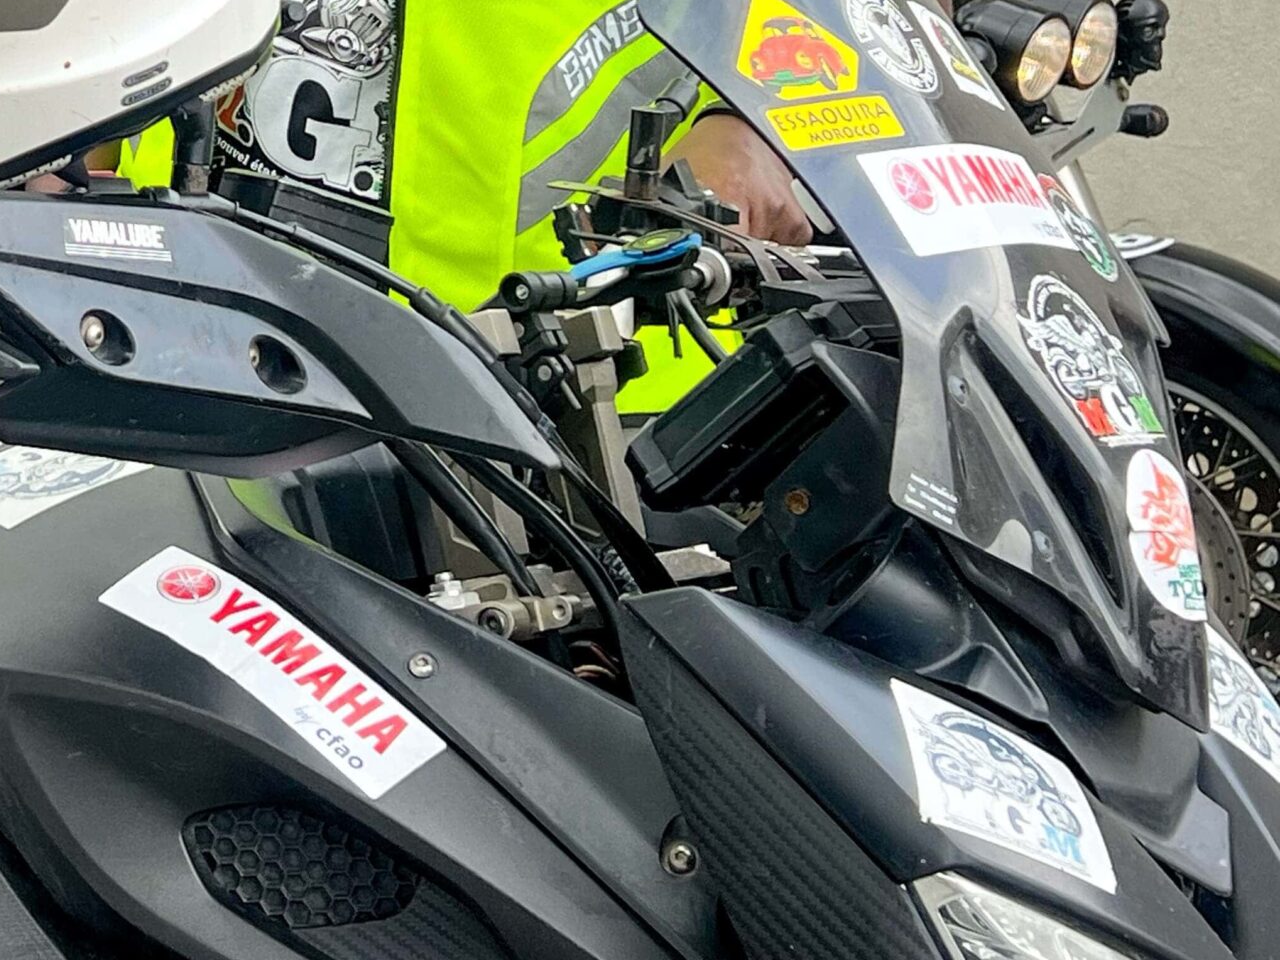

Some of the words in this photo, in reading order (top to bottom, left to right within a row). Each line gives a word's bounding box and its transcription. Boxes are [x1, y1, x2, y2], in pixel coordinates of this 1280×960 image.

[772, 102, 891, 132] ESSAOUIRA
[809, 122, 881, 144] MOROCCO
[922, 154, 1047, 210] YAMAHA
[68, 218, 165, 249] YAMALUBE
[209, 588, 409, 756] YAMAHA
[315, 727, 364, 770] cfao
